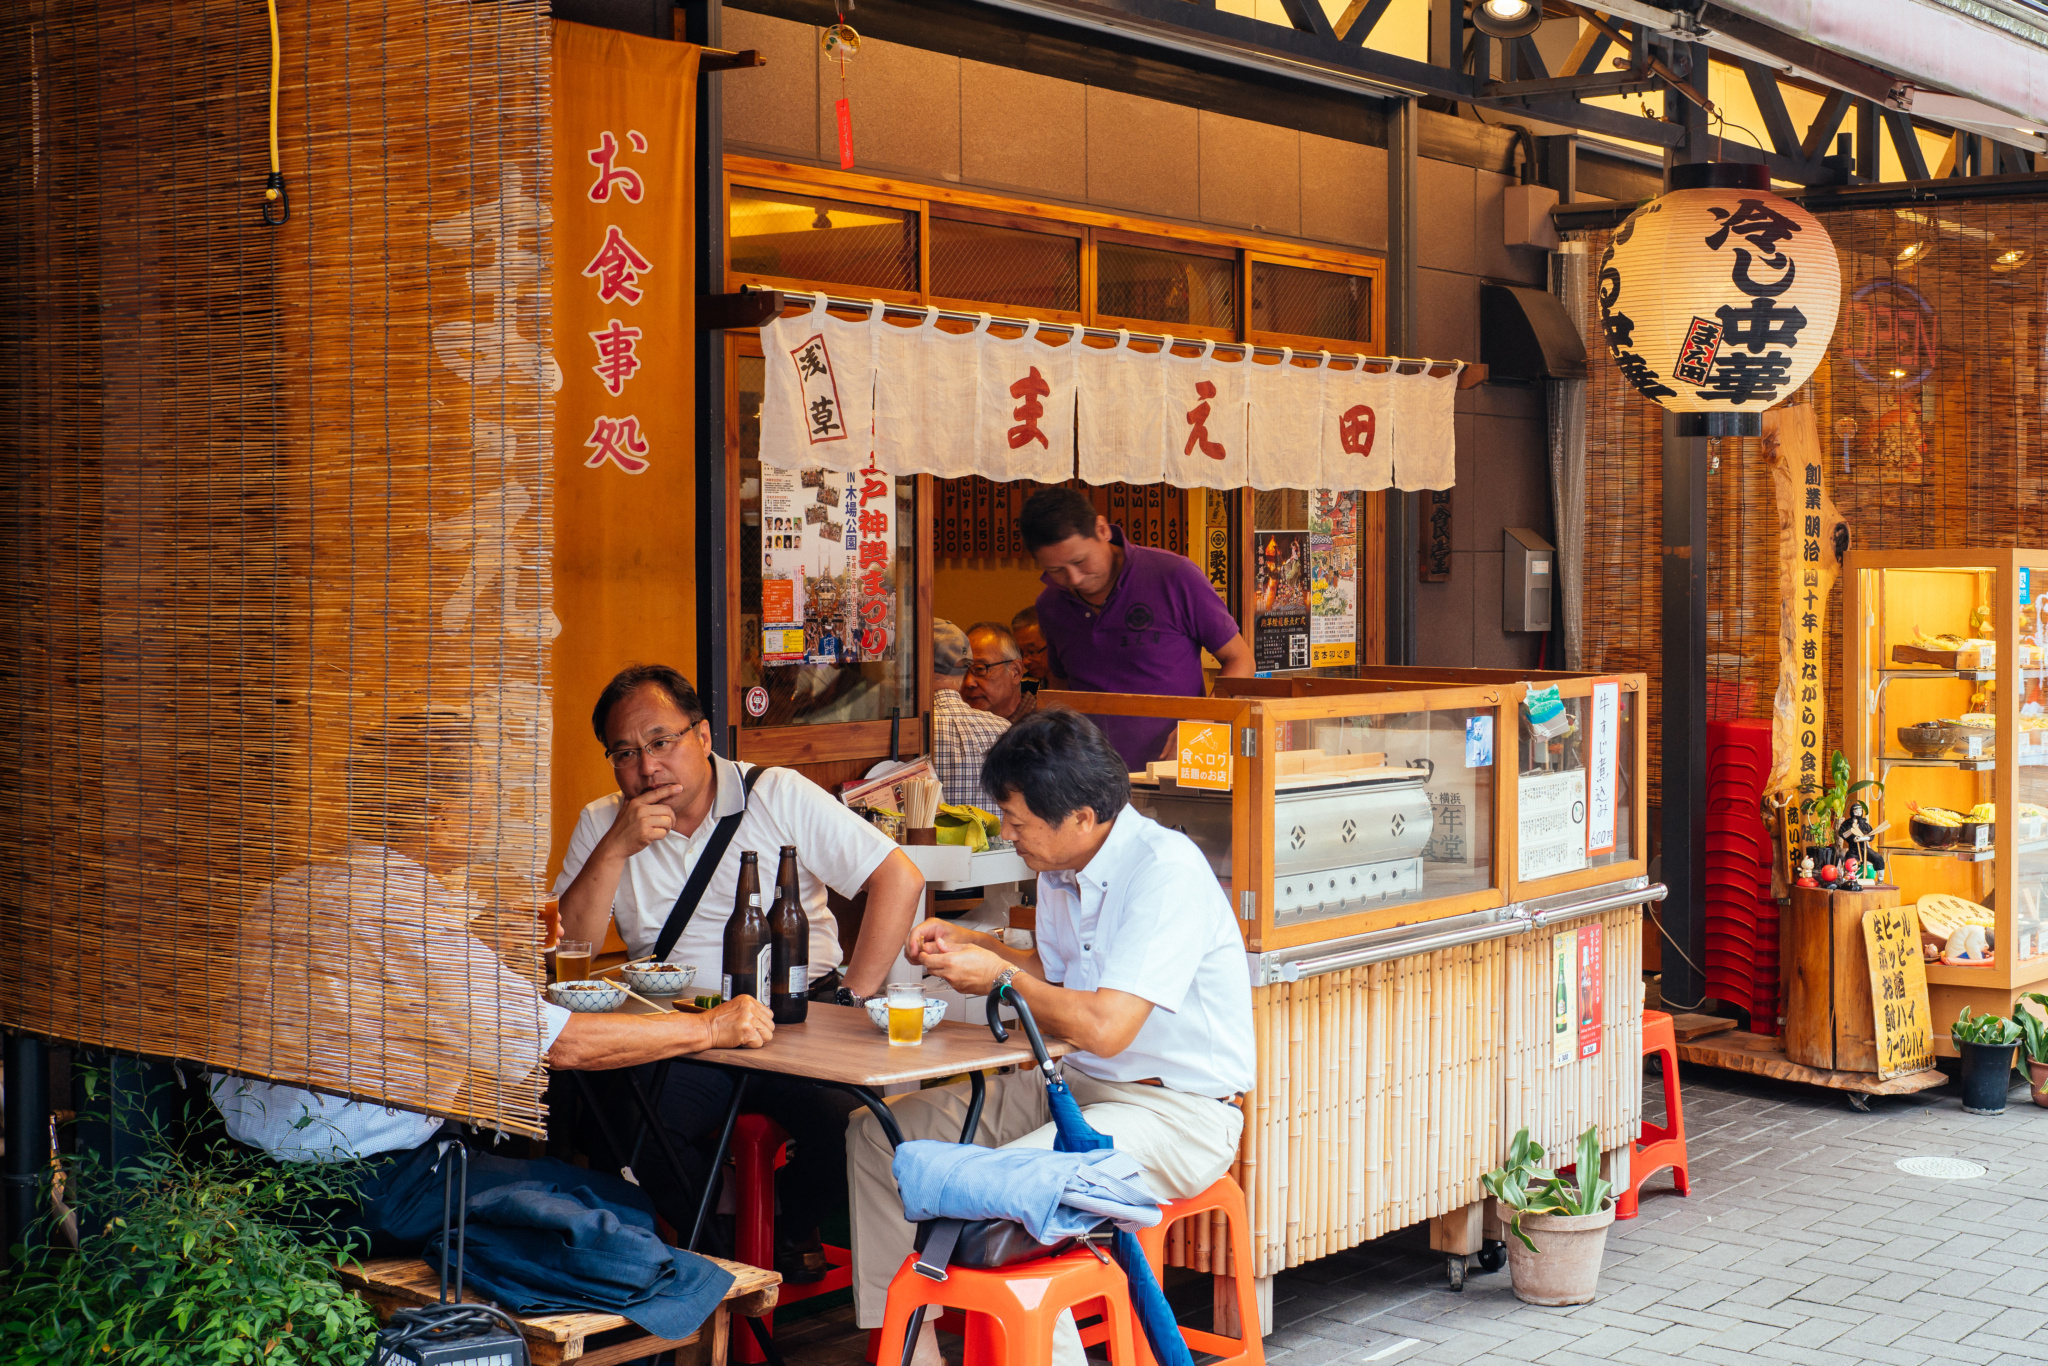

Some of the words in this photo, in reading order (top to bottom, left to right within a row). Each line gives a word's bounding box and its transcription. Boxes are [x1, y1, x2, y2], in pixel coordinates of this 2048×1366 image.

[581, 129, 654, 475] お食事処
[1695, 199, 1807, 405] 冷し中華
[1843, 301, 1937, 367] OPEN
[1680, 323, 1720, 382] まえ田
[799, 344, 840, 436] 浅草
[845, 485, 857, 551] 木場公園
[963, 518, 971, 551] 750
[978, 517, 988, 551] 650
[997, 518, 1005, 552] 1200
[1169, 518, 1177, 551] 400
[1181, 748, 1227, 767] 食べログ
[1595, 693, 1611, 818] 牛すじ煮込み
[1181, 767, 1227, 782] 話題のお店
[1787, 806, 1801, 866] 商い中
[1873, 911, 1911, 943] 生ビール
[1878, 939, 1915, 970] ホッピー
[1882, 970, 1906, 1001] お酒
